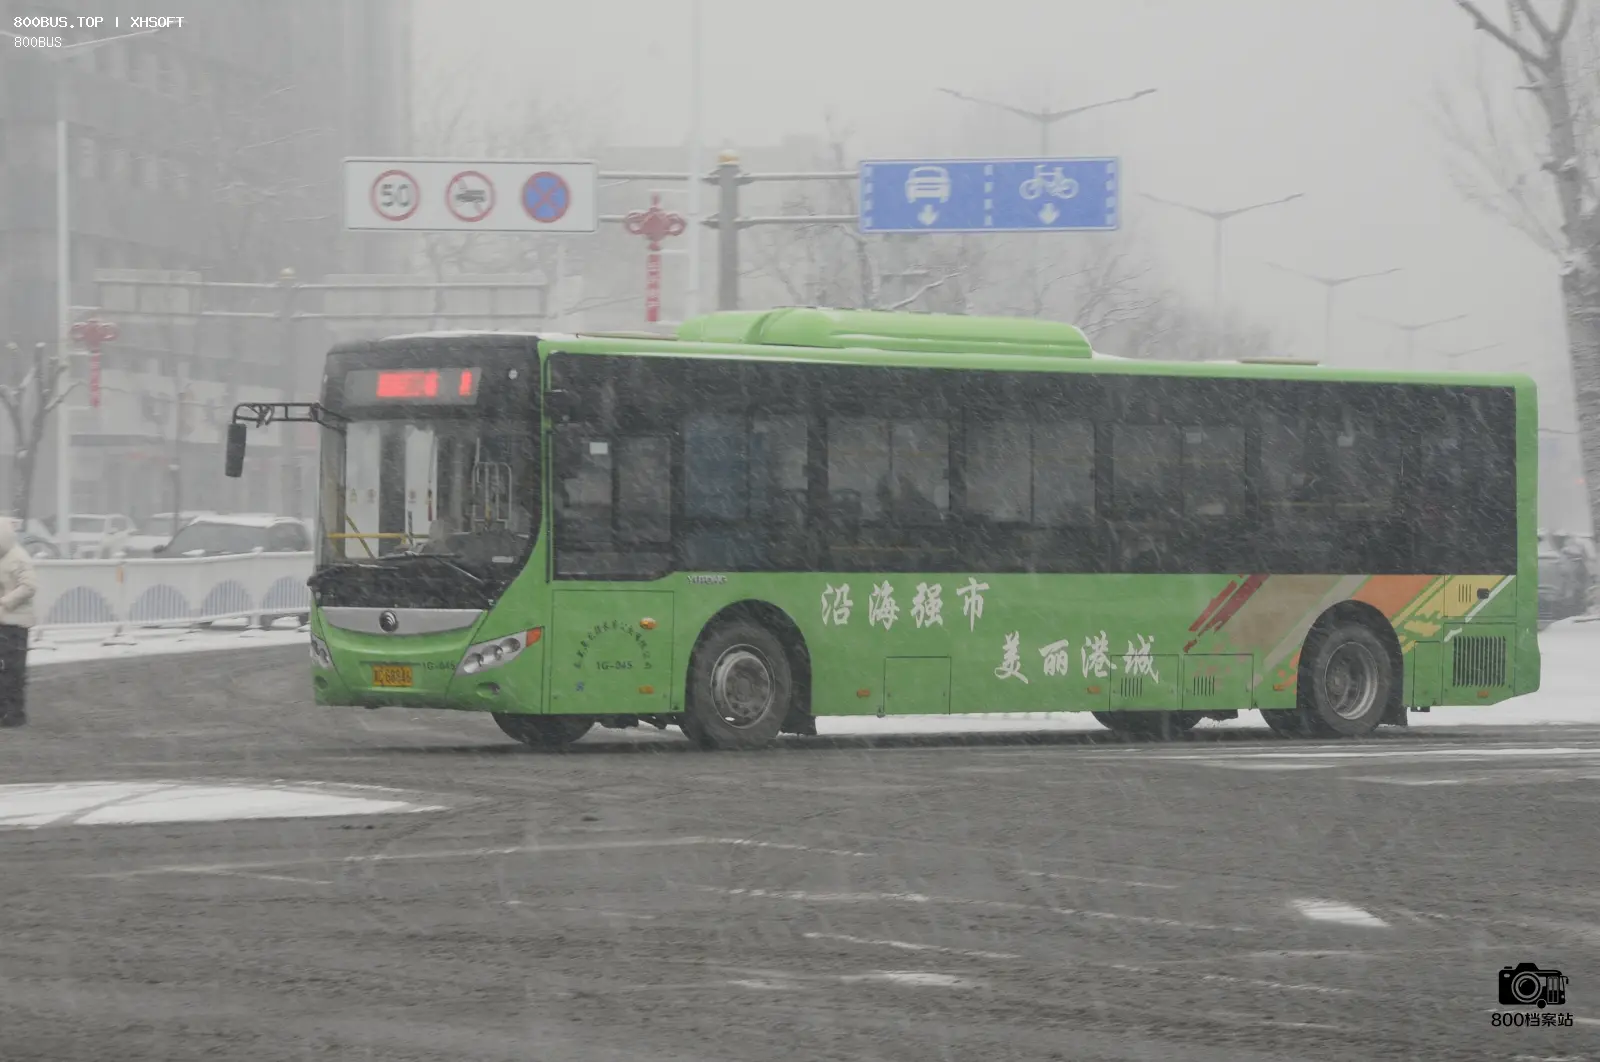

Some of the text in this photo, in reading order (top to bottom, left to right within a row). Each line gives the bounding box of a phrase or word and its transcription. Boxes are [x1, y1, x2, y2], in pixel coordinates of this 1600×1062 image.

[380, 183, 412, 208] 50
[820, 577, 990, 632] 沿海强市
[994, 630, 1160, 684] 美丽港城
